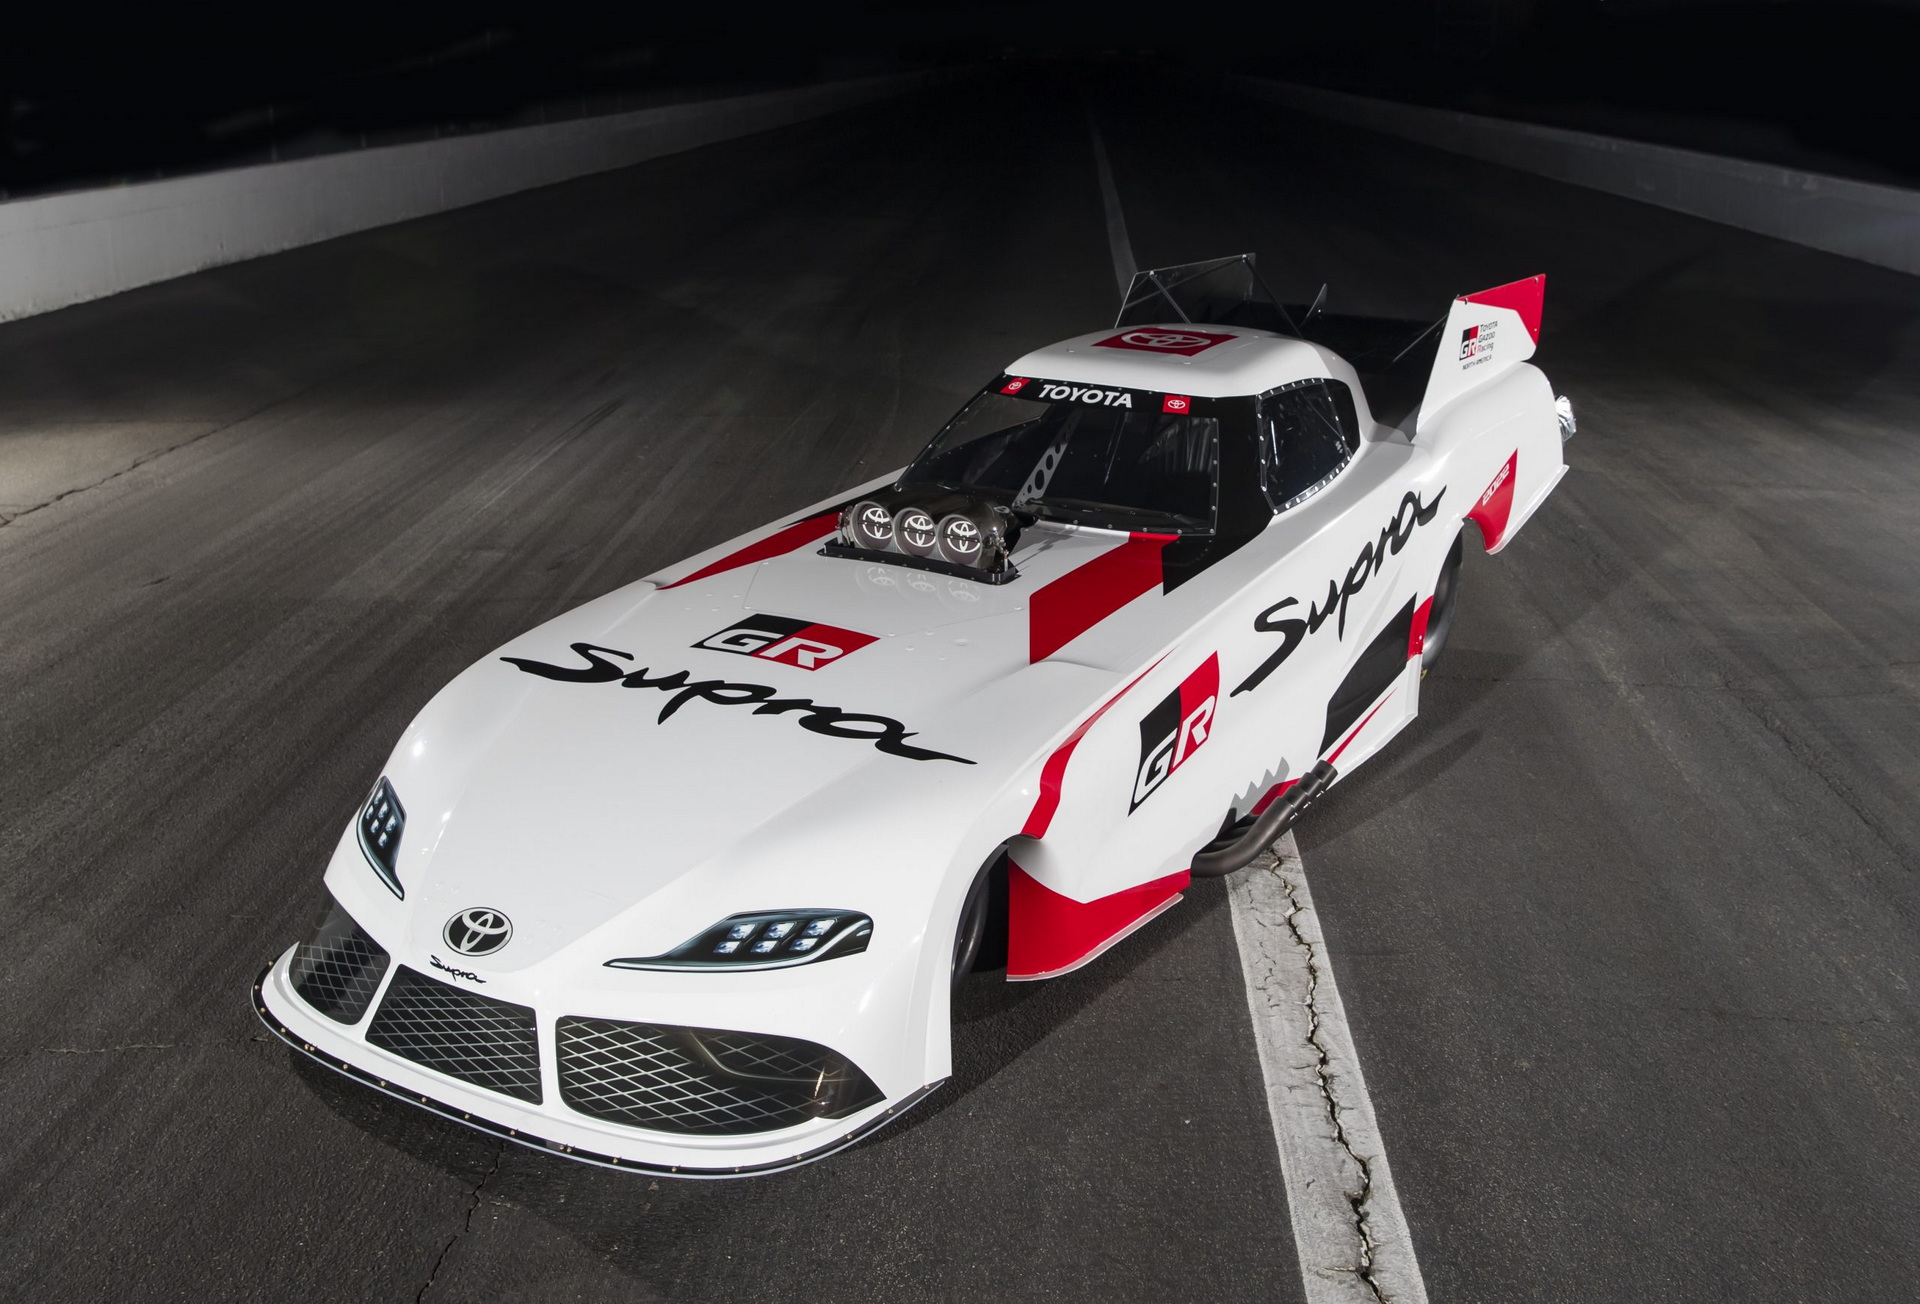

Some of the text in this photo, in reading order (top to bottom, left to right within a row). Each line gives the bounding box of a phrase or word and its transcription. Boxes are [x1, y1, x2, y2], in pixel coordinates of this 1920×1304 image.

[1476, 342, 1494, 353] Racing
[1038, 384, 1133, 408] TOYOTA
[1482, 462, 1509, 507] 2022
[1229, 485, 1447, 698] Supra
[702, 628, 844, 669] GR
[499, 642, 978, 765] Supra
[1133, 695, 1216, 804] GR
[429, 954, 487, 984] Supra
